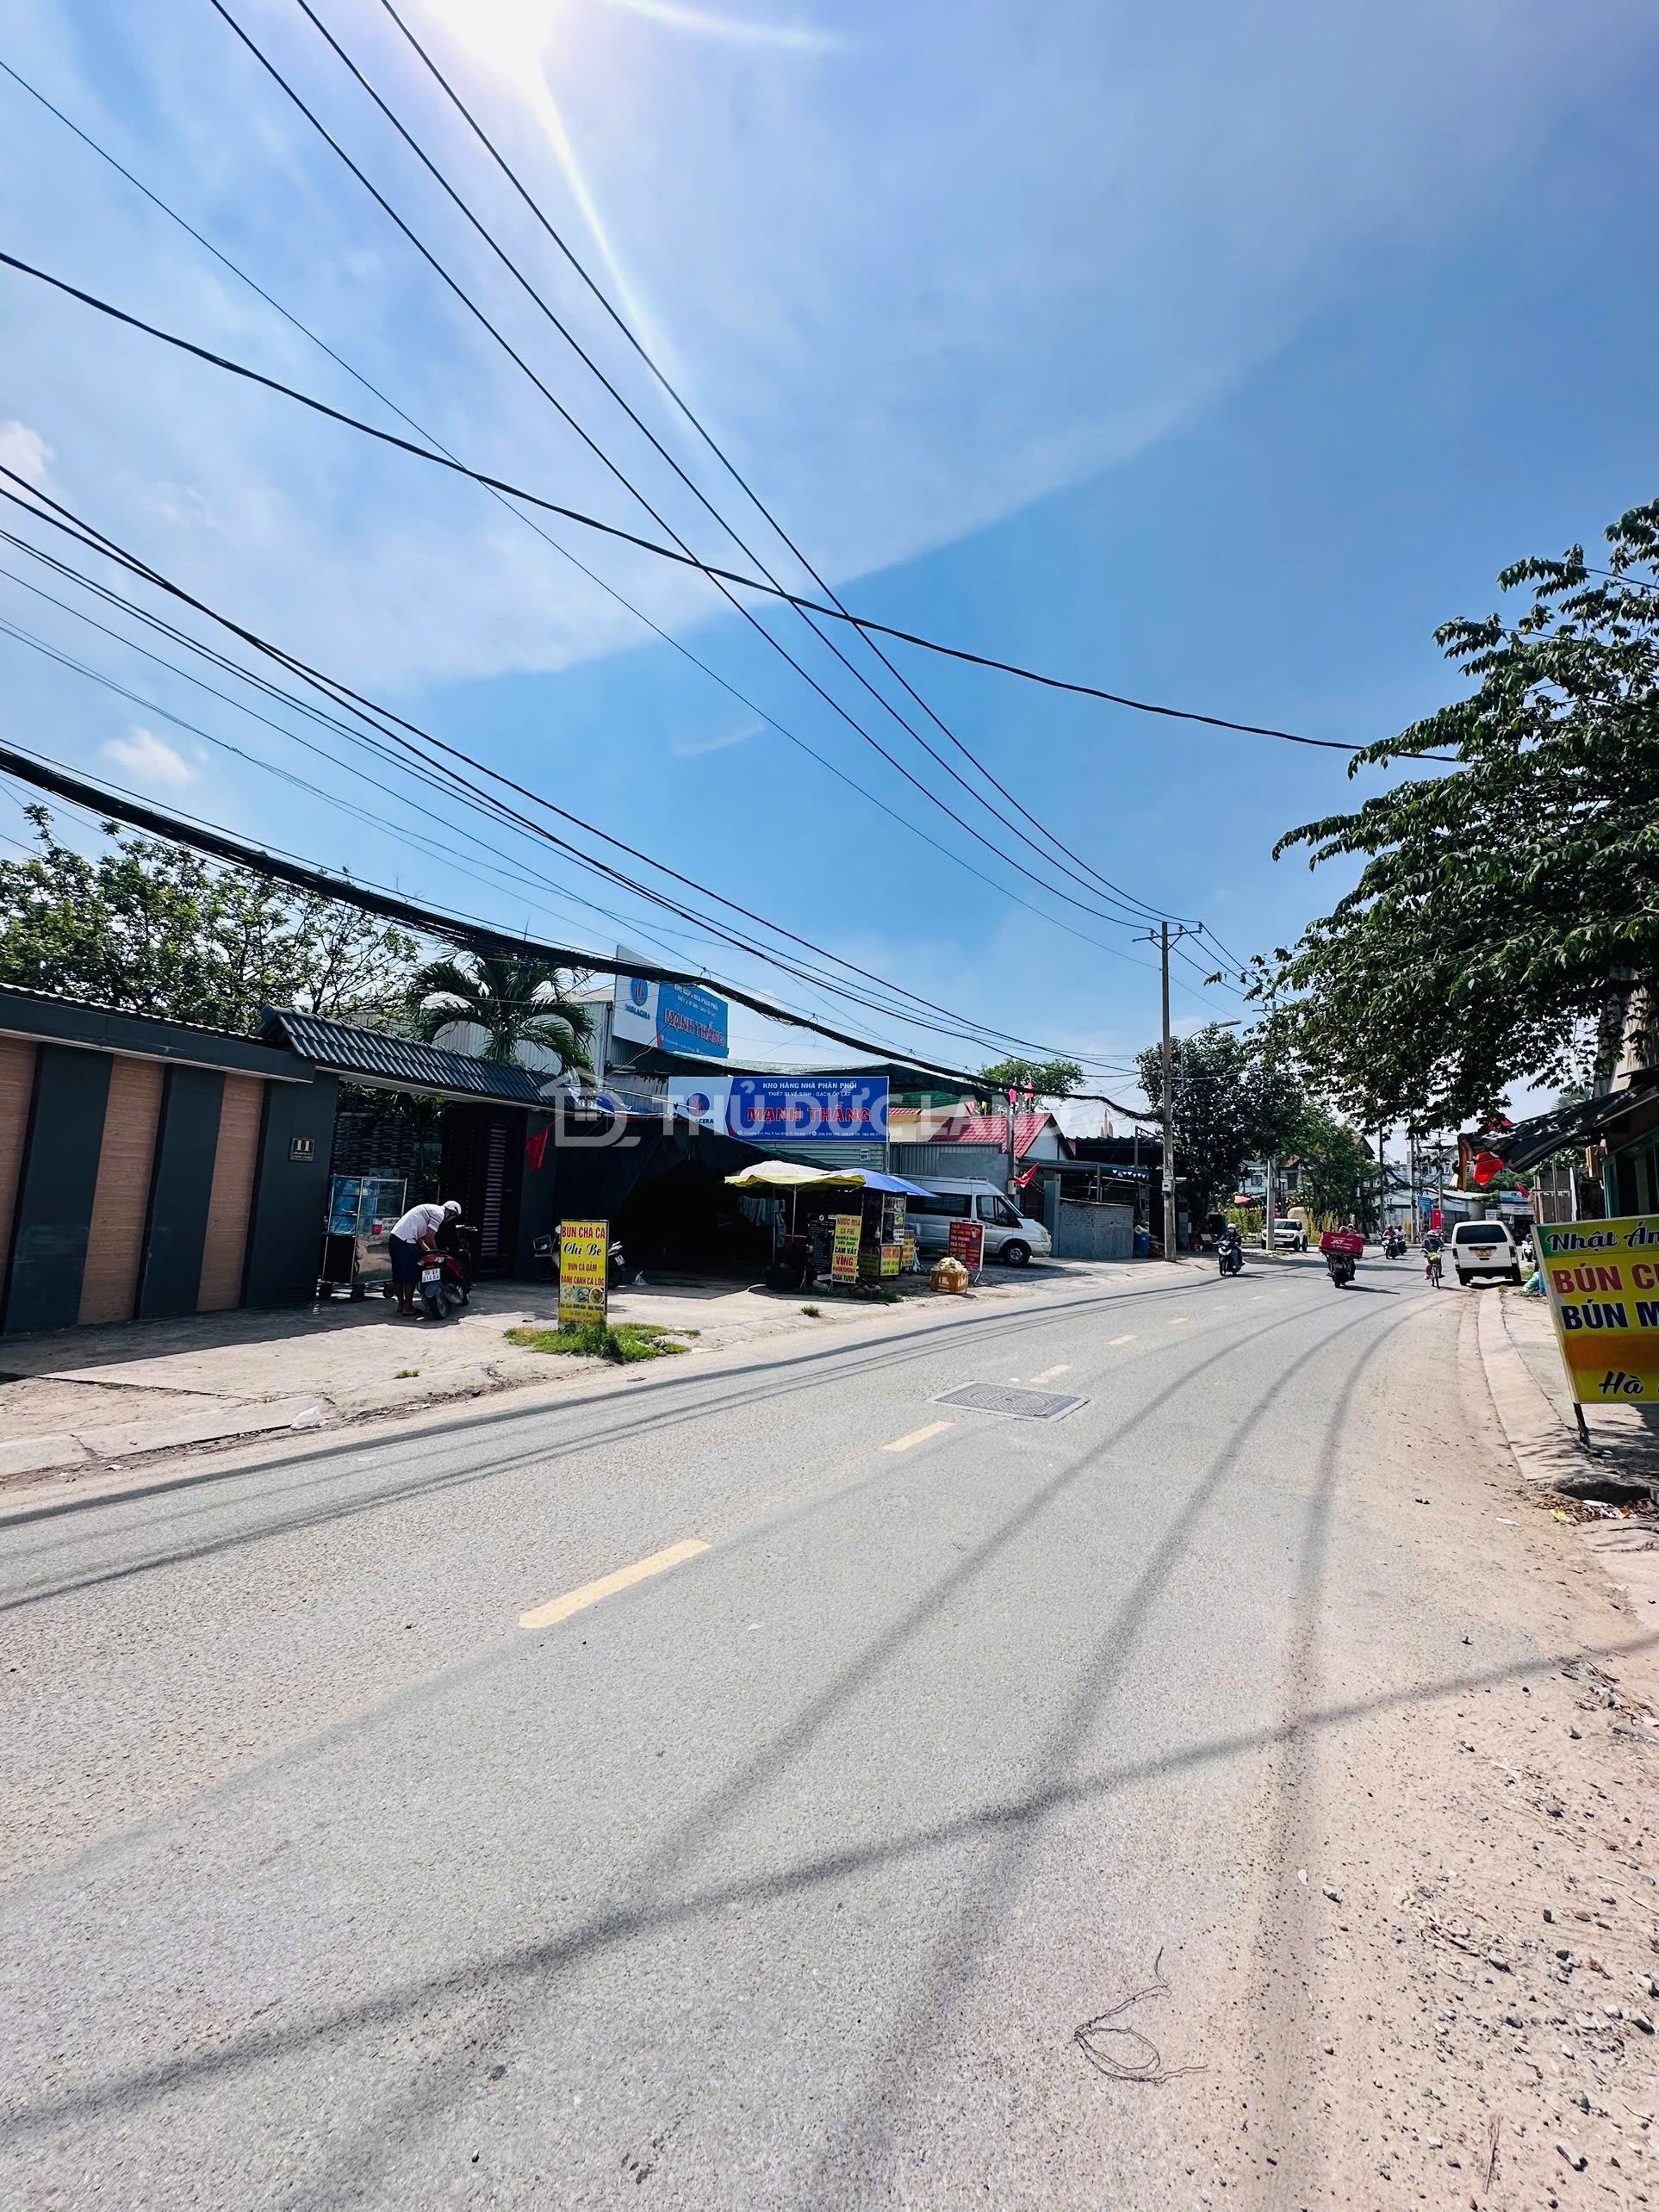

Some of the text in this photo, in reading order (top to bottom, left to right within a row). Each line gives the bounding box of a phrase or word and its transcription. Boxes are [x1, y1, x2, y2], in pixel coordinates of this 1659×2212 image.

[664, 1009, 693, 1034] MẠNH
[696, 1022, 724, 1047] THẮNG
[840, 1080, 857, 1089] PHỐI
[748, 1102, 871, 1124] MẠNH THẮNG
[296, 1140, 310, 1151] 11
[562, 1224, 576, 1238] BÚN
[579, 1223, 593, 1238] CHẢ
[564, 1242, 582, 1258] Chị
[1546, 1231, 1618, 1252] Nhật
[1552, 1262, 1623, 1294] BÚN
[1561, 1299, 1628, 1330] BÚN
[1599, 1370, 1643, 1395] Hà
